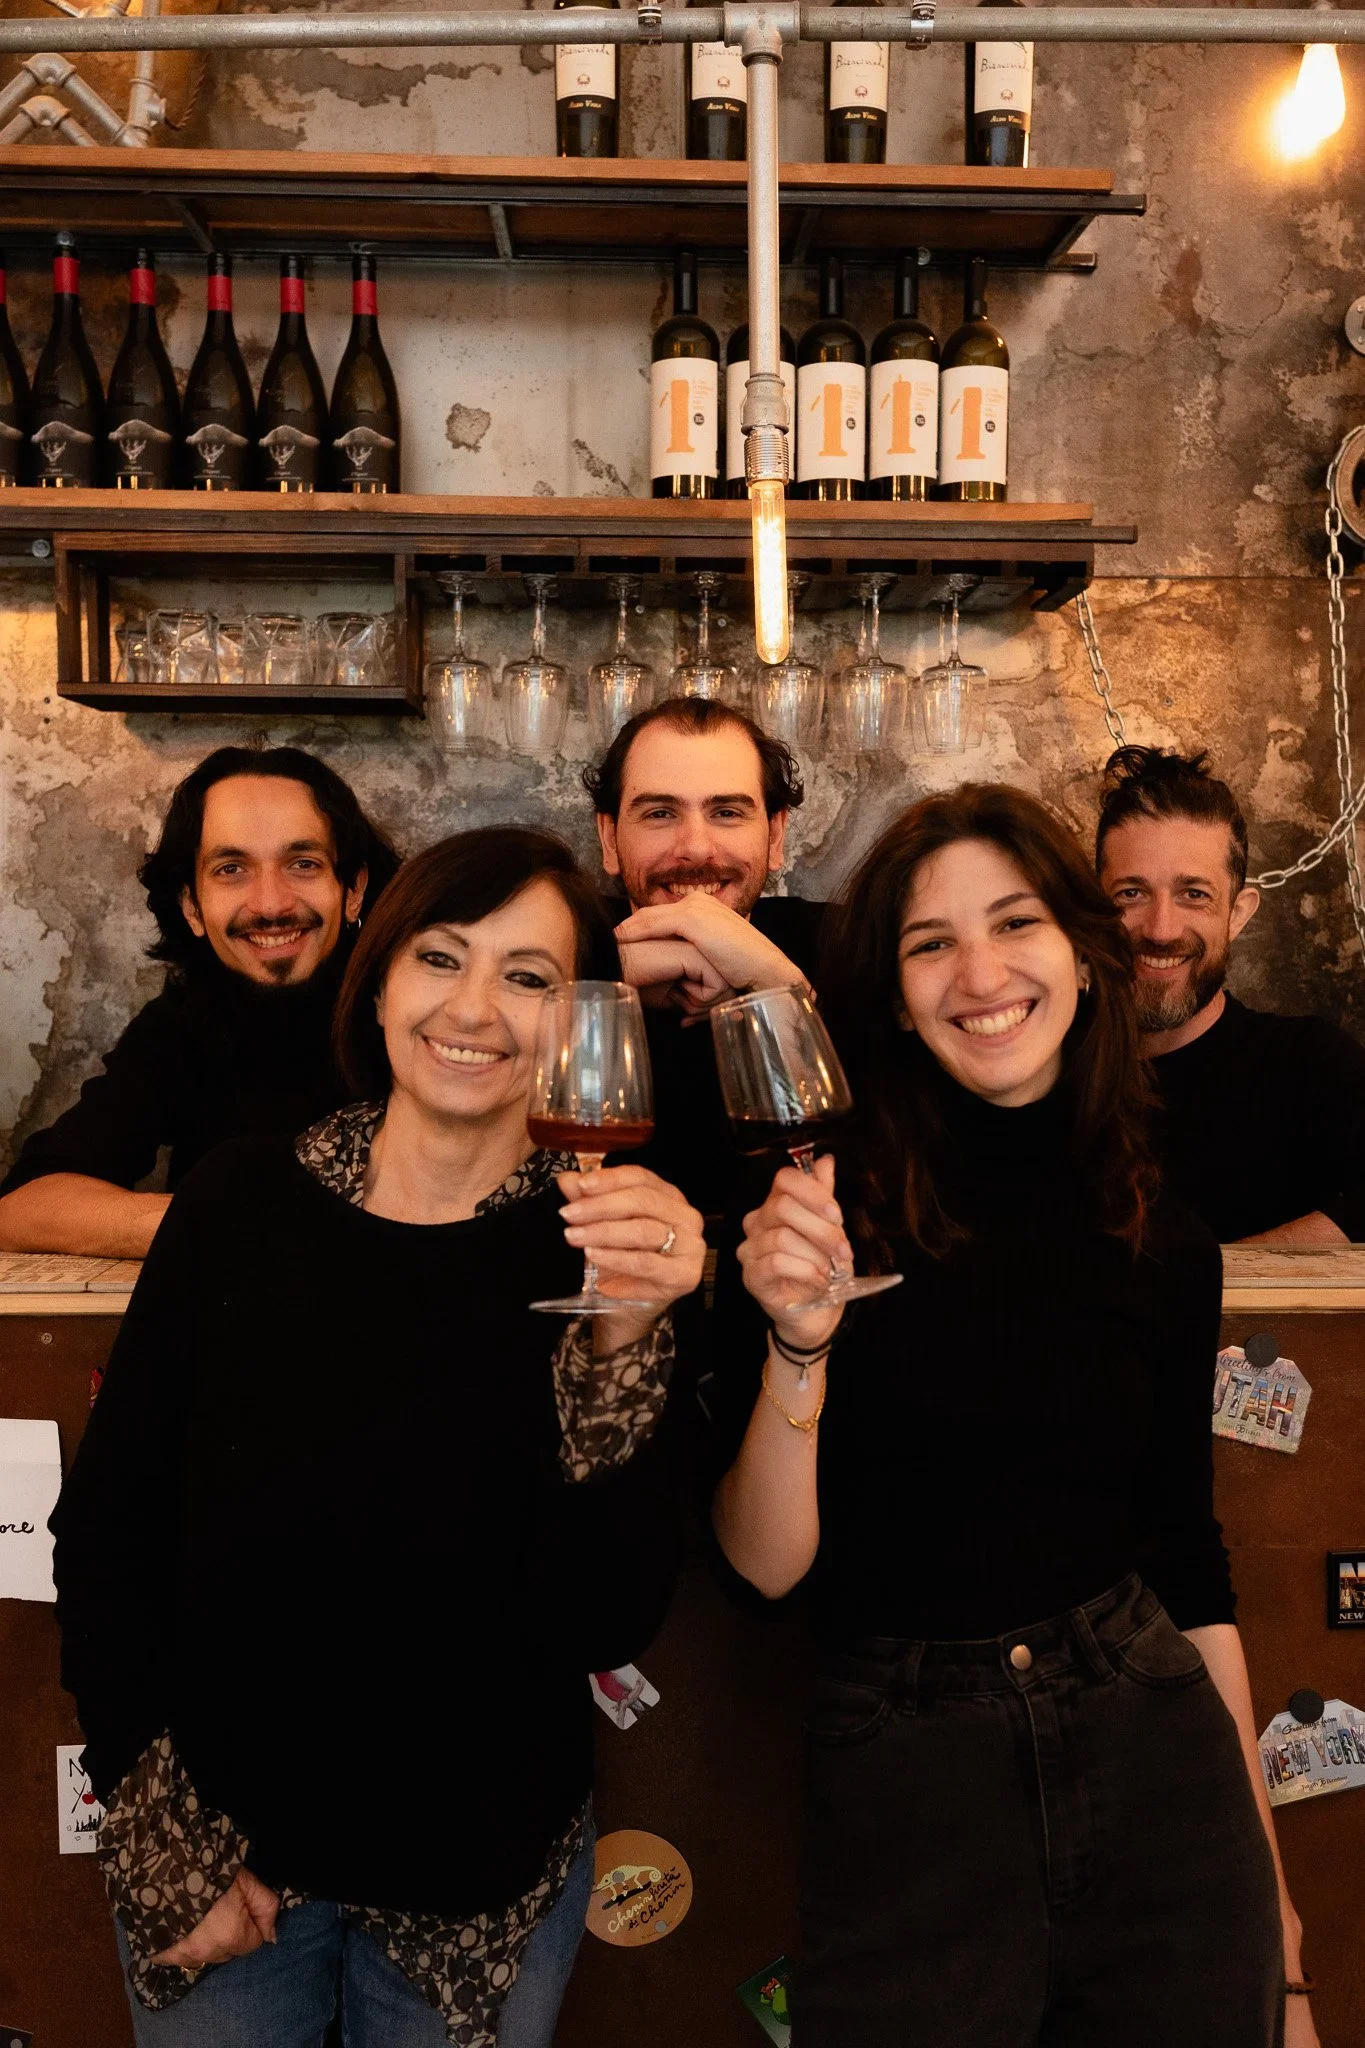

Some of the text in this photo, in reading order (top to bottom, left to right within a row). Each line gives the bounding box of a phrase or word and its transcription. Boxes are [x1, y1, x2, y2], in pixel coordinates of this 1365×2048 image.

[1212, 1367, 1298, 1437] UTAH
[1339, 1612, 1364, 1620] NEW
[1262, 1740, 1311, 1790] NEW
